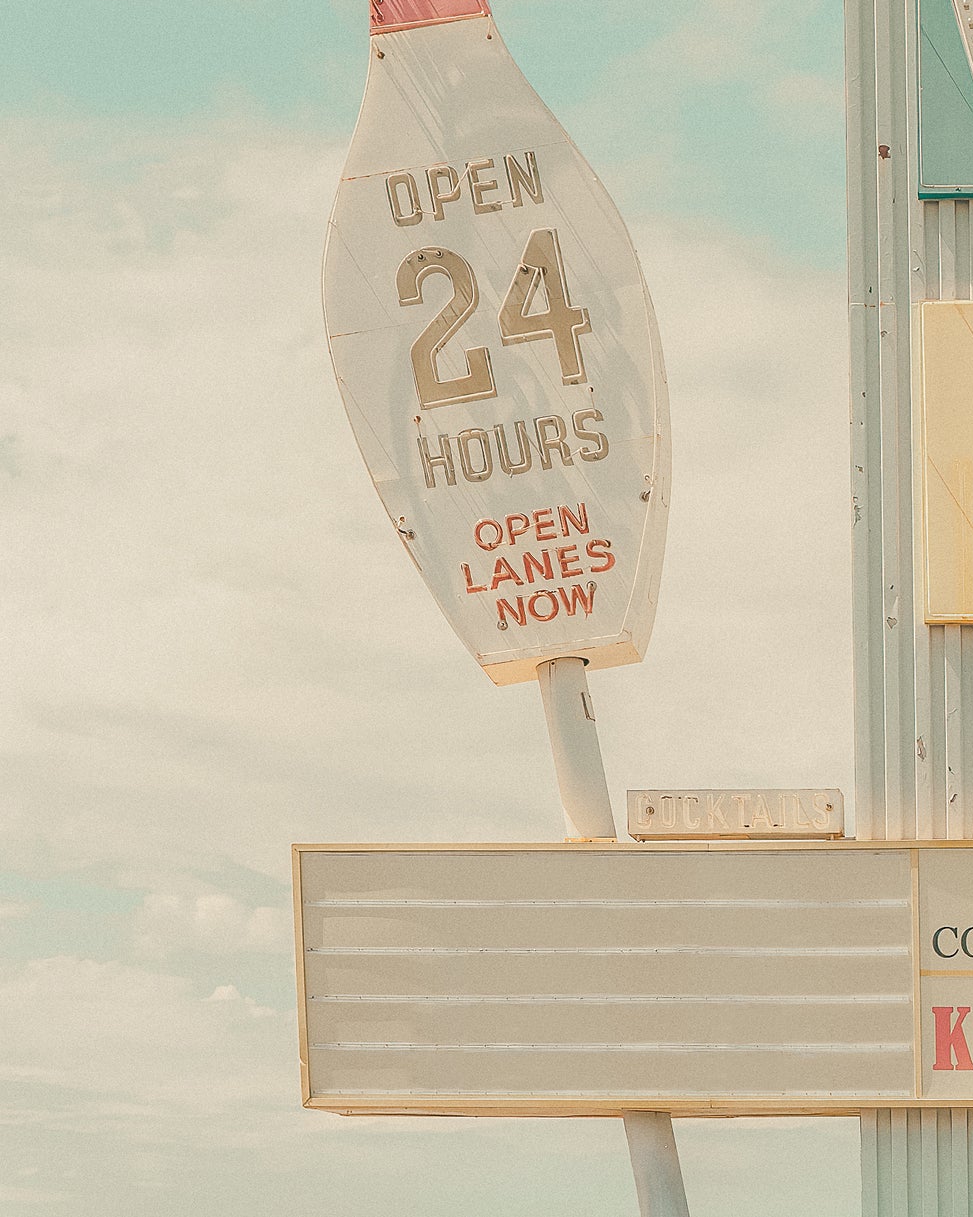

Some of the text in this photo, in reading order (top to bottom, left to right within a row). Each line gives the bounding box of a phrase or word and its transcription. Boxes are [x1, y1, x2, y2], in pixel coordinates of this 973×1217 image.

[385, 151, 545, 227] OPEN
[395, 228, 592, 411] 24
[416, 407, 610, 489] HOURS
[473, 501, 590, 551] OPEN
[460, 538, 616, 594] LANES
[495, 583, 597, 628] NOW
[634, 792, 831, 830] COCKTAILS
